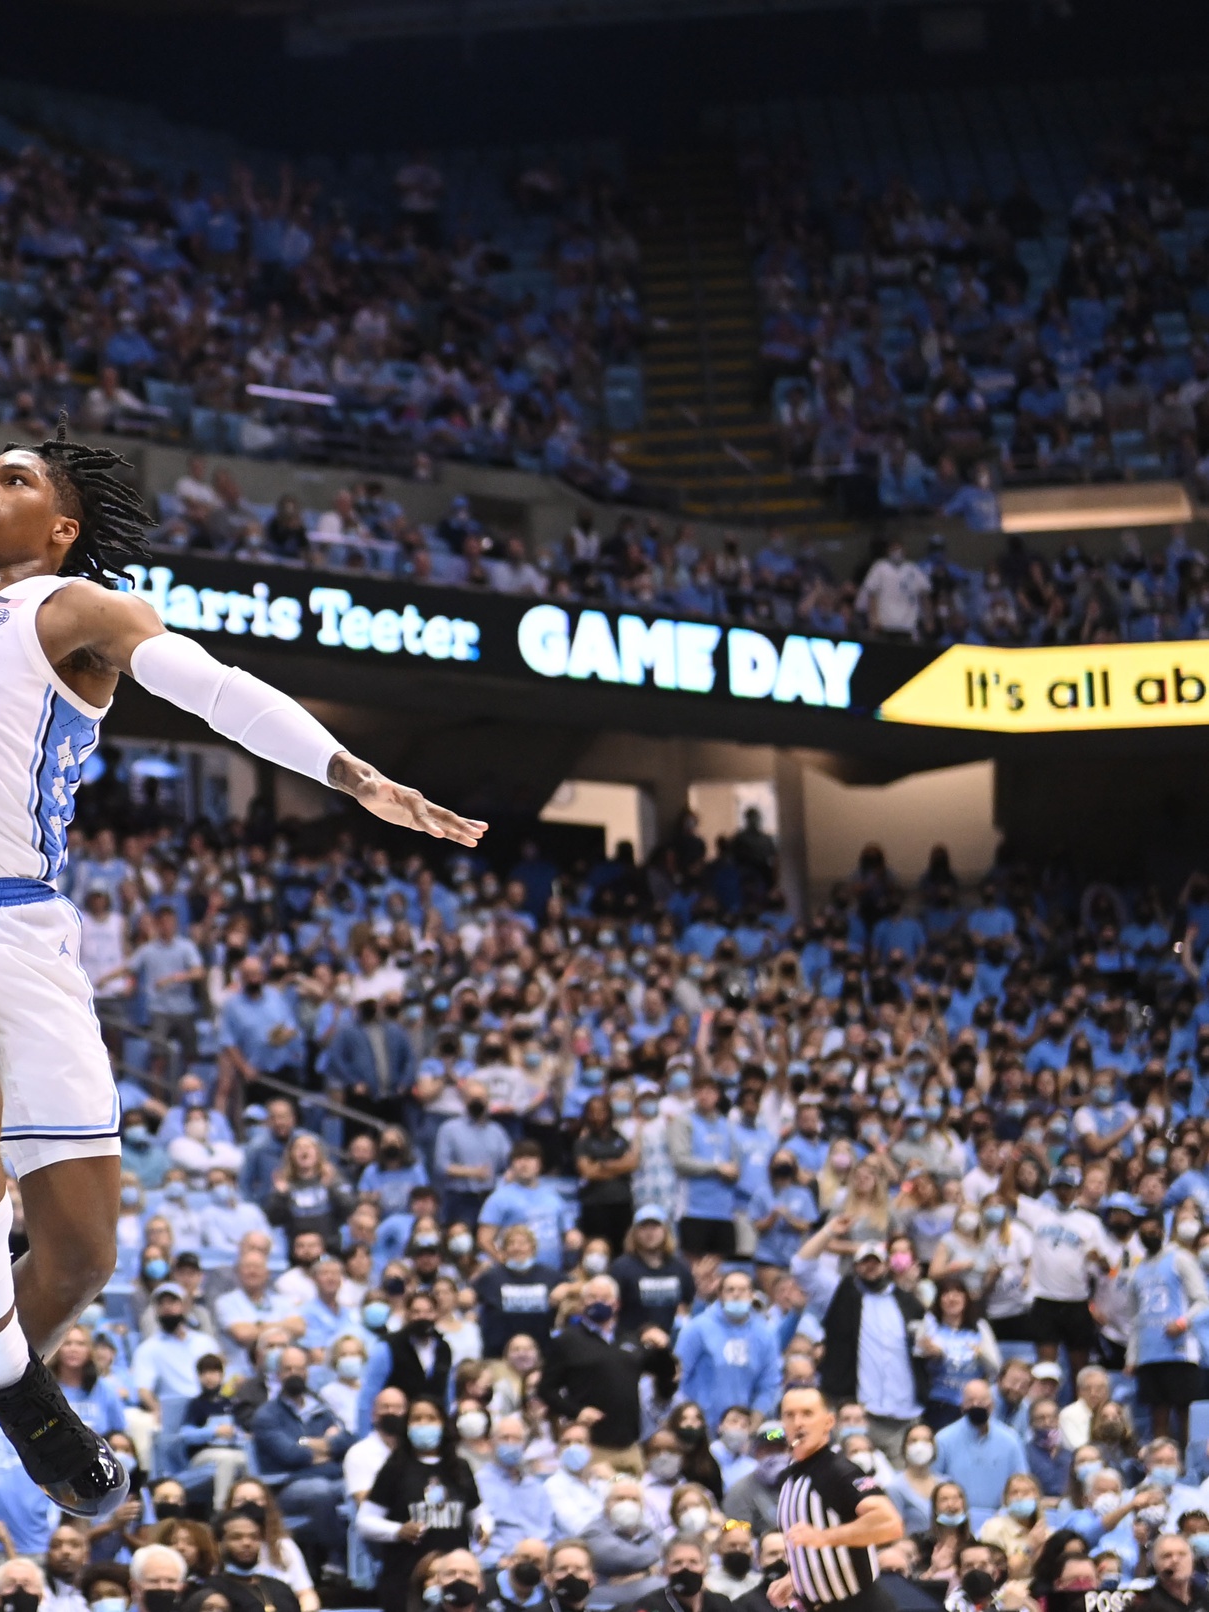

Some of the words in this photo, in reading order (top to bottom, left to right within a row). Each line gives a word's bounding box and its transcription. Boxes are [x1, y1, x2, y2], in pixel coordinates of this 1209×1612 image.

[119, 564, 302, 641] Harris
[309, 587, 481, 662] Teeter
[517, 603, 722, 693] GAME
[727, 627, 863, 708] DAY
[965, 669, 1025, 711] It's
[1047, 670, 1111, 709] all
[1135, 666, 1207, 706] ab
